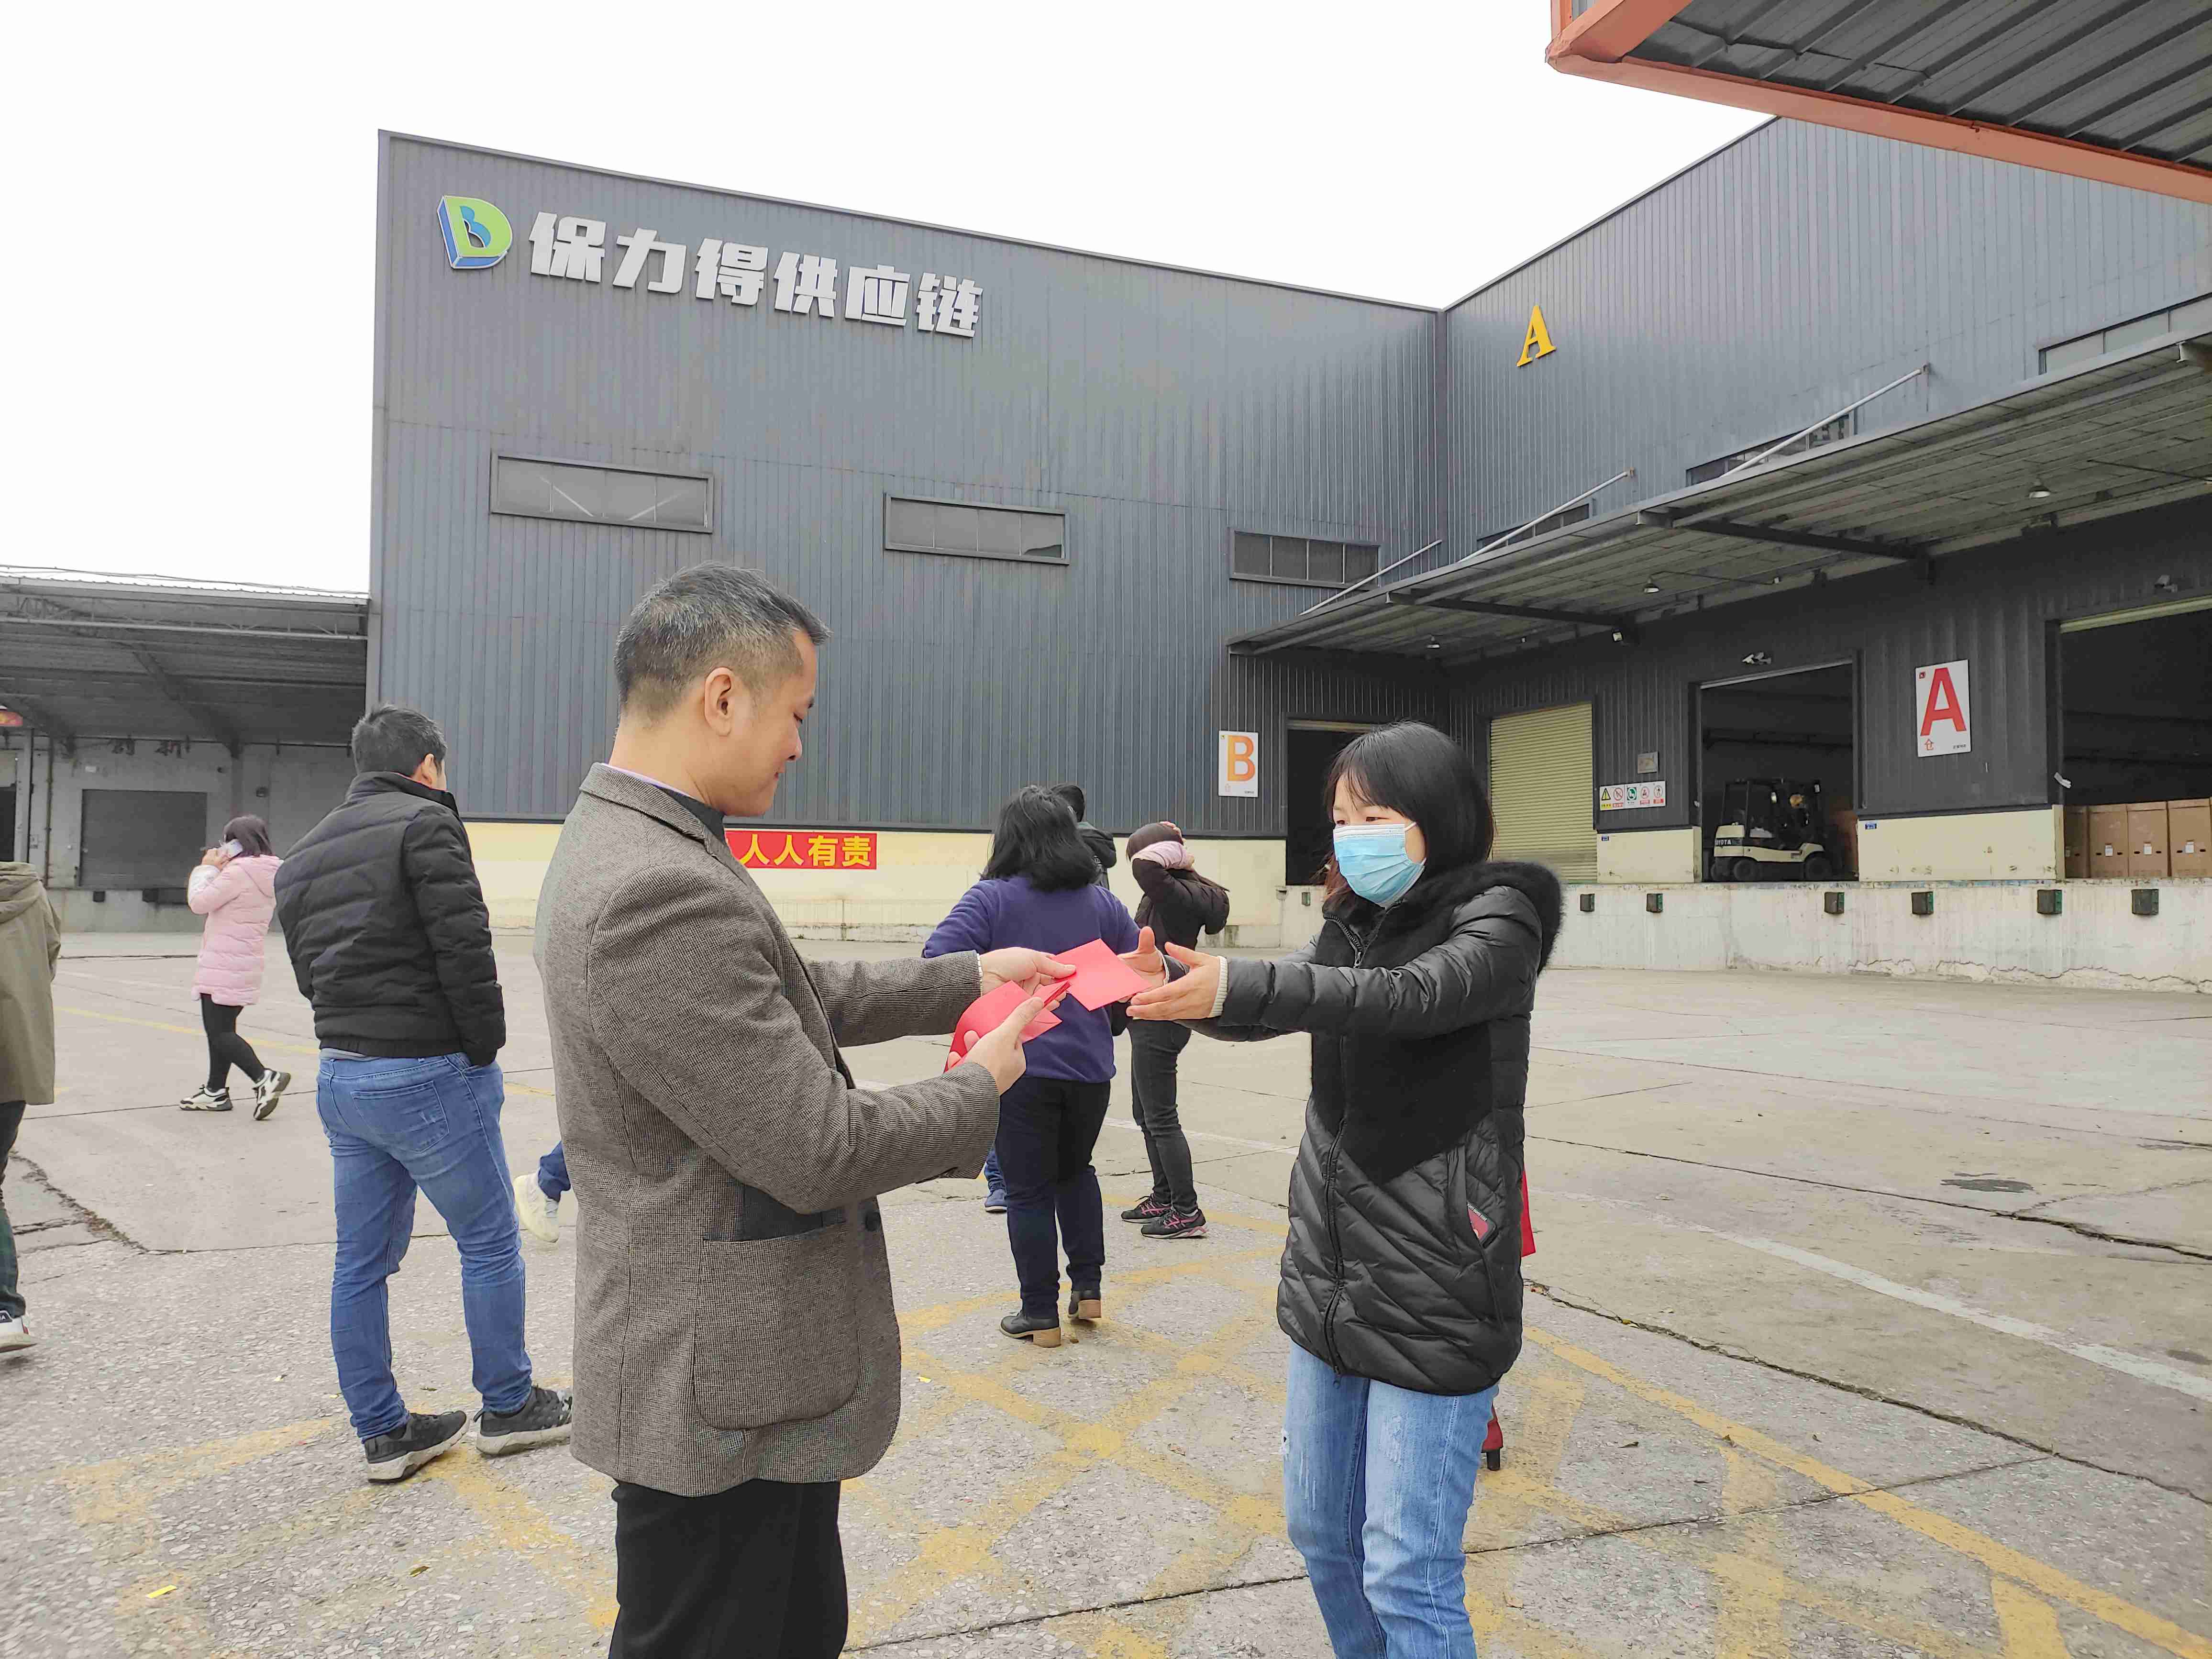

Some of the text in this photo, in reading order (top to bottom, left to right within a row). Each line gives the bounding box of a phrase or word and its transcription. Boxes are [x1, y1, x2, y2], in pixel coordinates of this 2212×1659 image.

[528, 211, 983, 337] 保力得供应链
[1516, 304, 1557, 367] A
[1921, 667, 1967, 736] A
[1228, 734, 1255, 781] B
[739, 834, 871, 867] 人人有责
